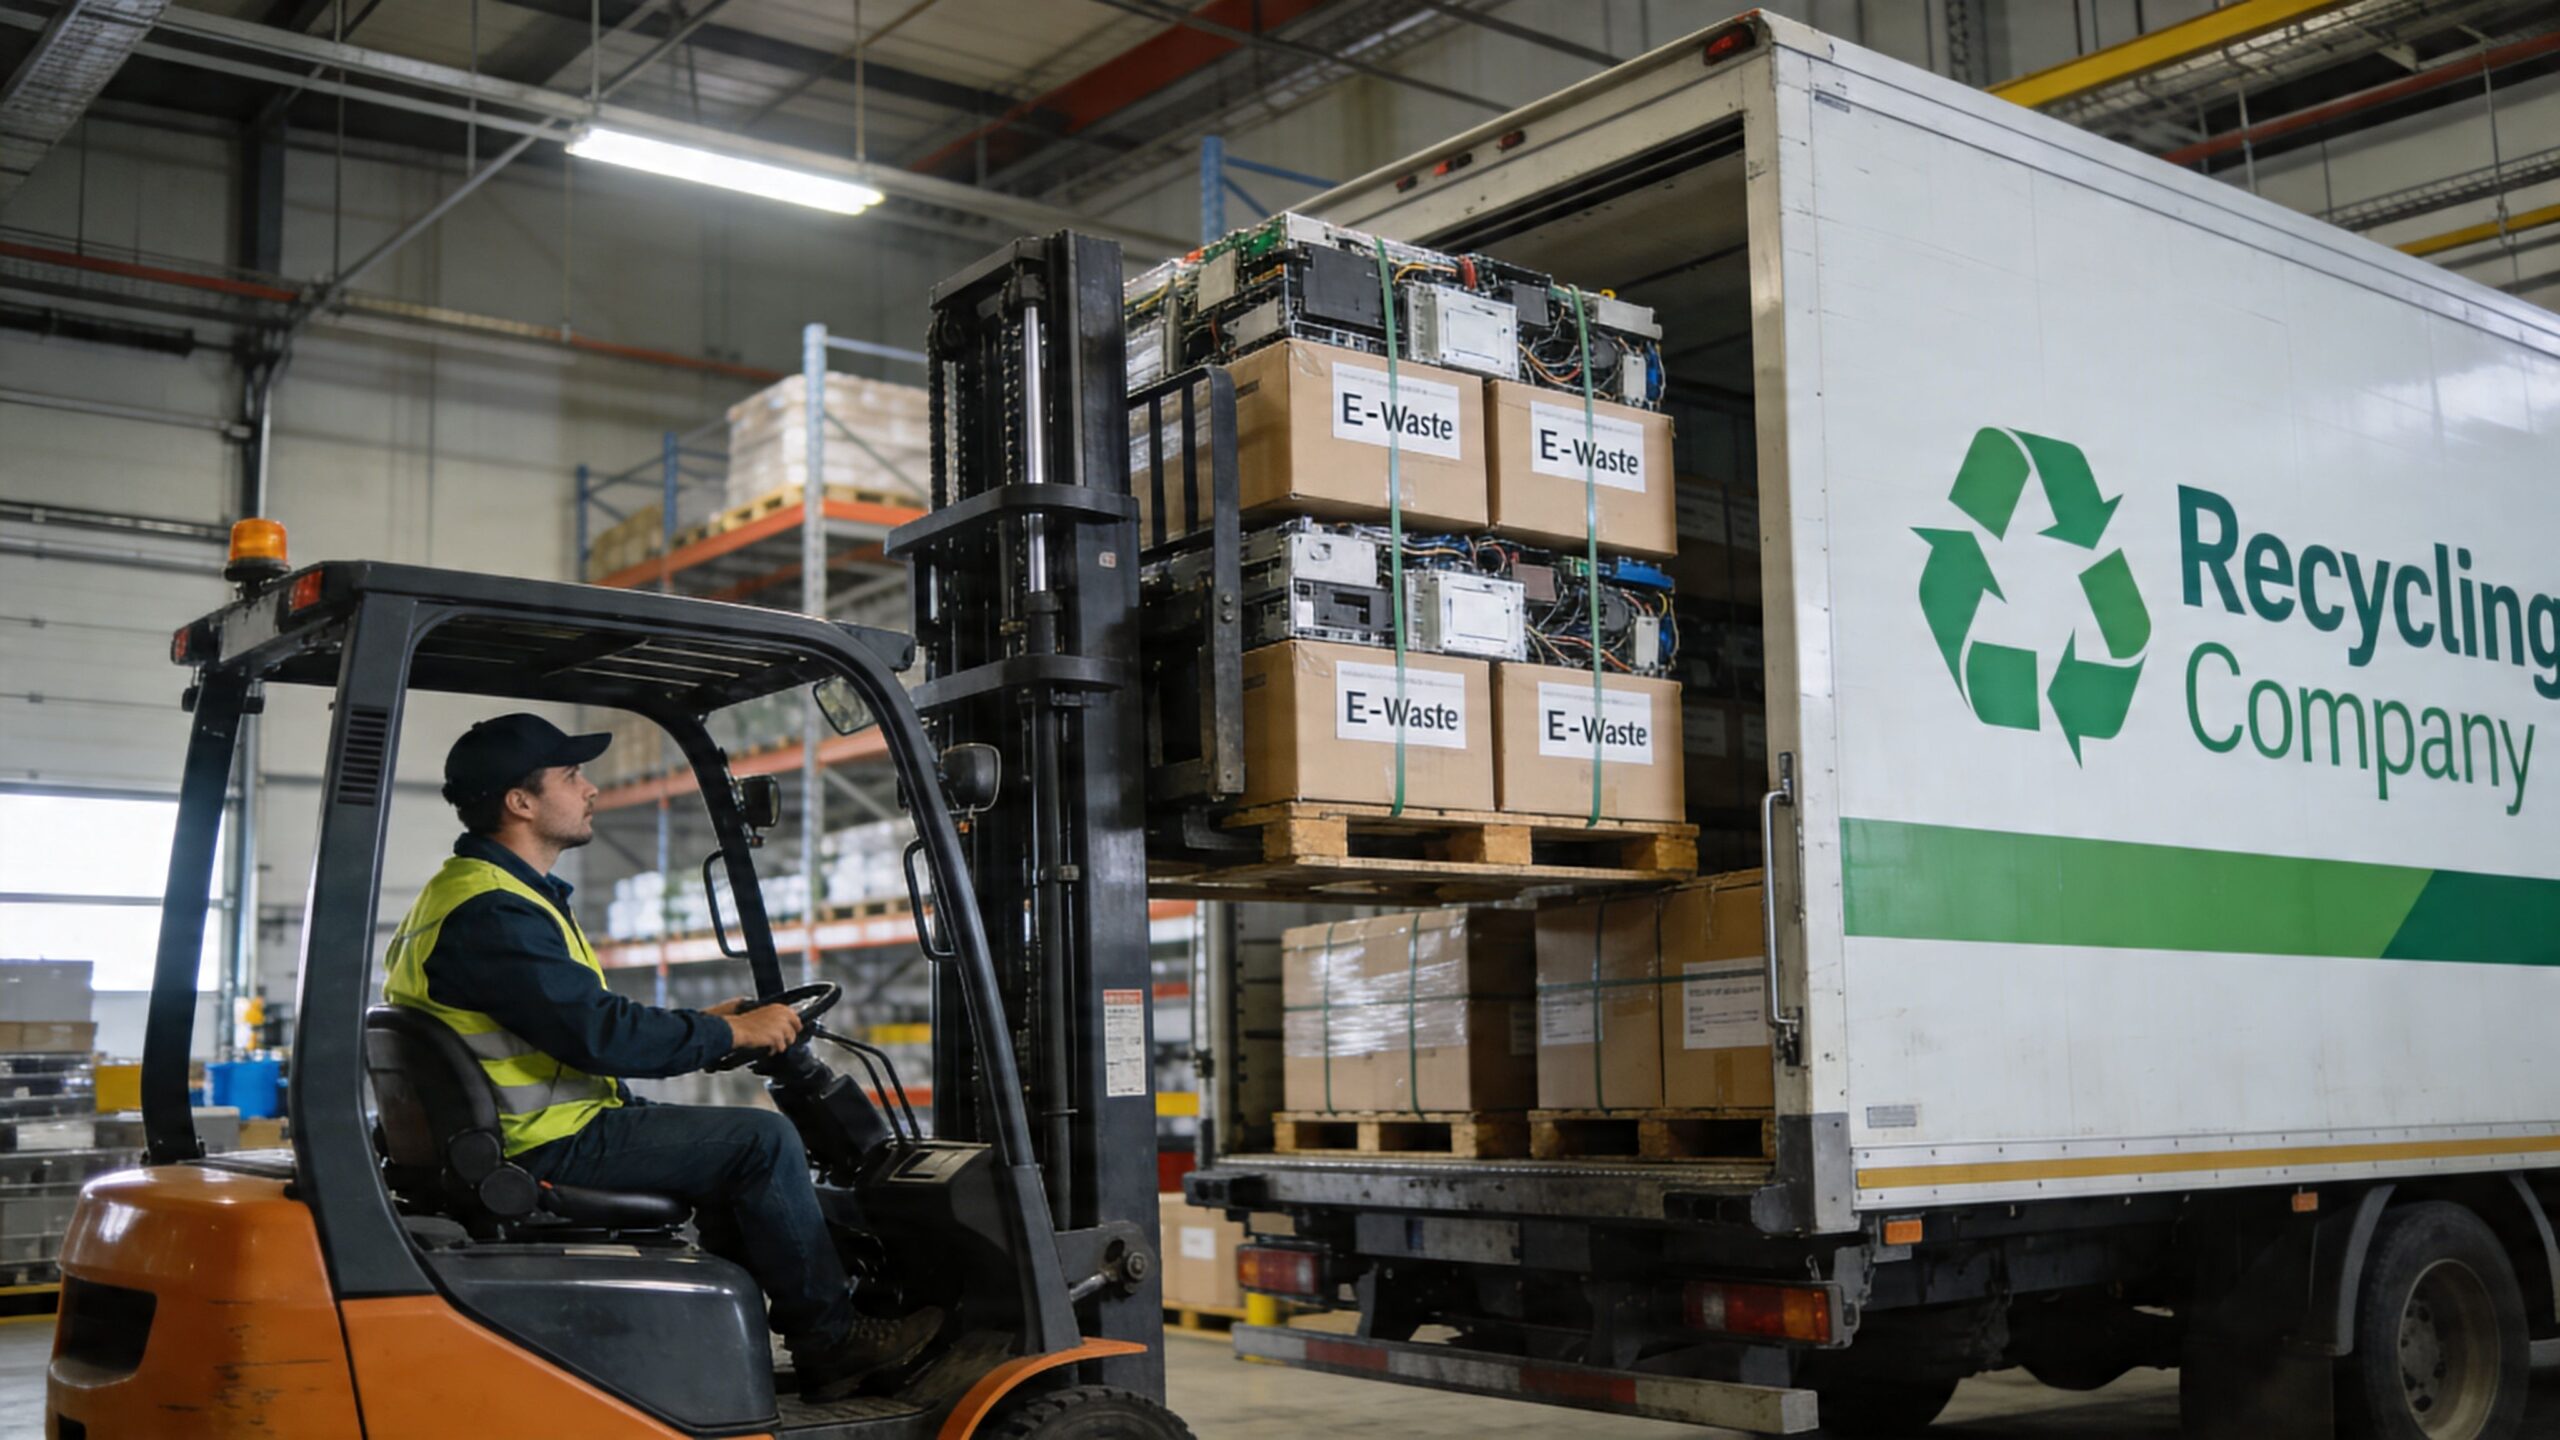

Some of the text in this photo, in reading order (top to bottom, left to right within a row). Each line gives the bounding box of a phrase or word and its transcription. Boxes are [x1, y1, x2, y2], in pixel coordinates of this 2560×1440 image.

[1343, 392, 1453, 440] E-Waste
[1540, 428, 1638, 475] E-Waste
[2178, 484, 2560, 700] Recycling
[1346, 690, 1458, 731] E-Waste
[1548, 709, 1647, 746] E-Waste
[2186, 641, 2535, 816] Company
